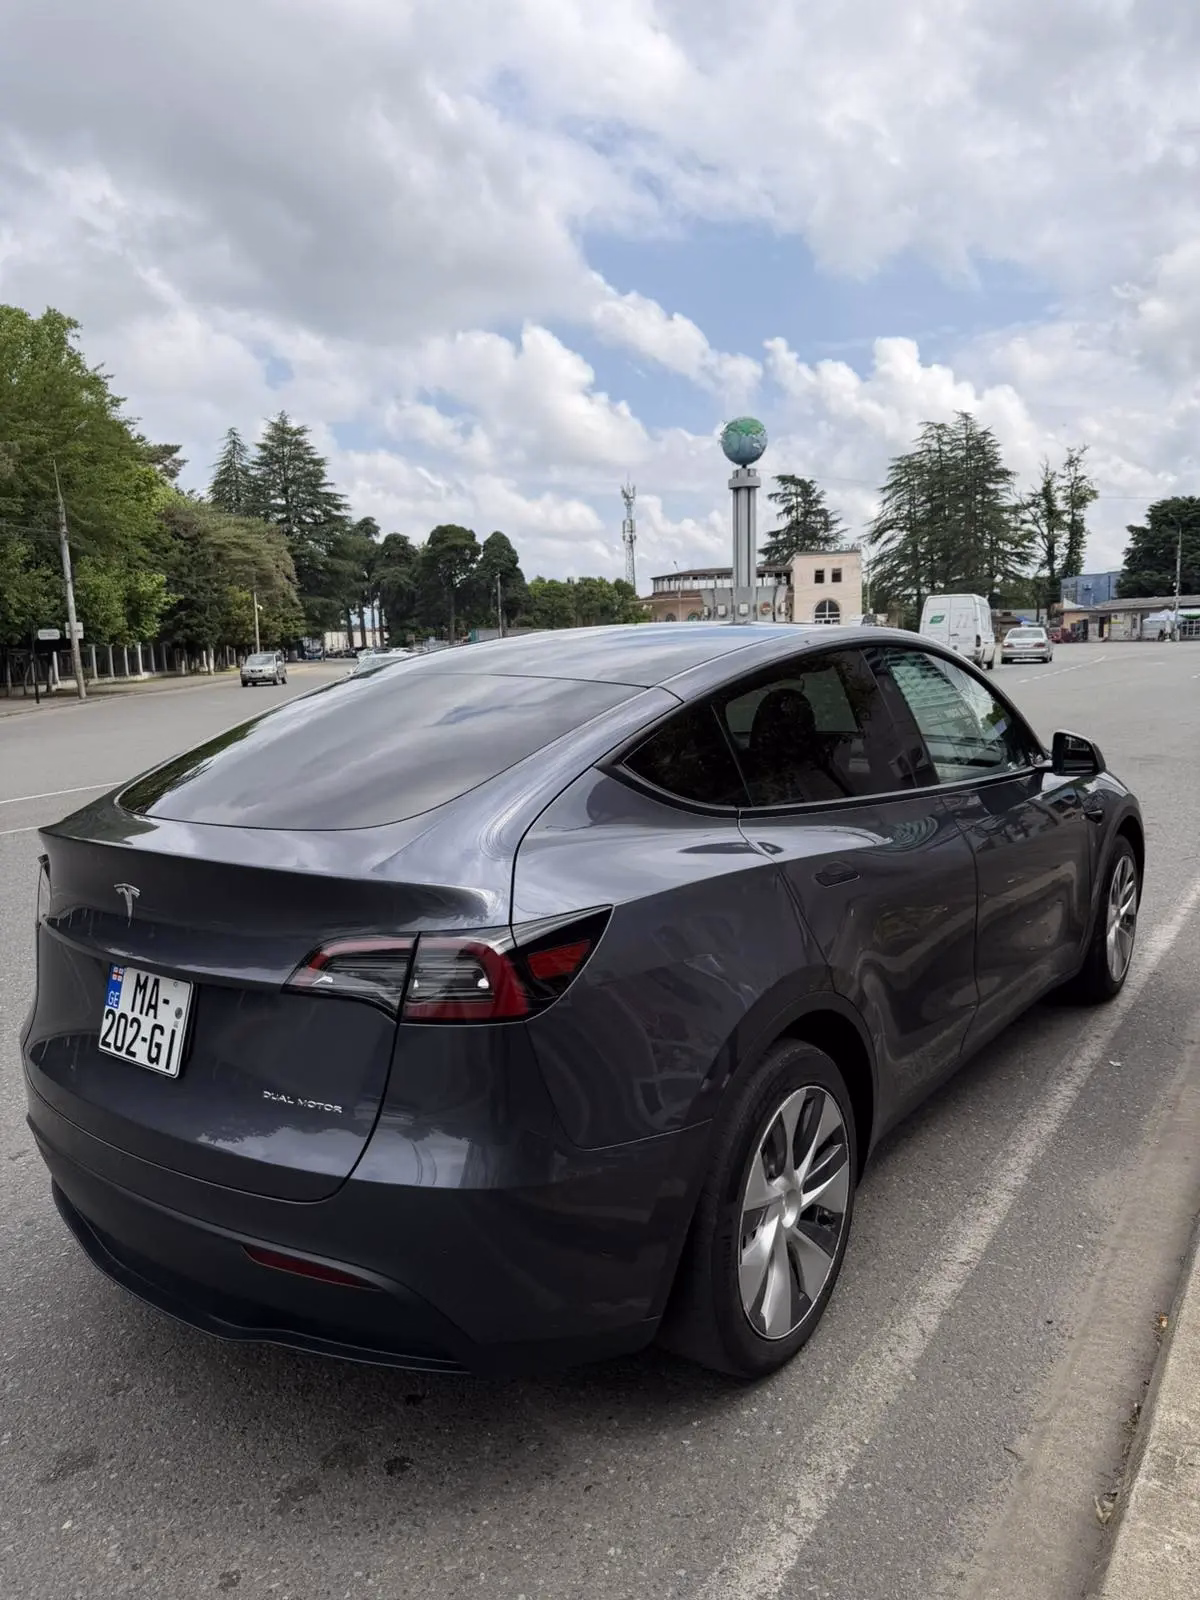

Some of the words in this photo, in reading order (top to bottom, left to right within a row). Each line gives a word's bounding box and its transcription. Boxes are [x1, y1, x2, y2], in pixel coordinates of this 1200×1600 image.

[107, 990, 120, 1008] GE
[131, 973, 170, 1020] MA-
[100, 1008, 176, 1070] 202-GI
[263, 1090, 294, 1105] DUAL
[297, 1098, 342, 1113] MOTOR
